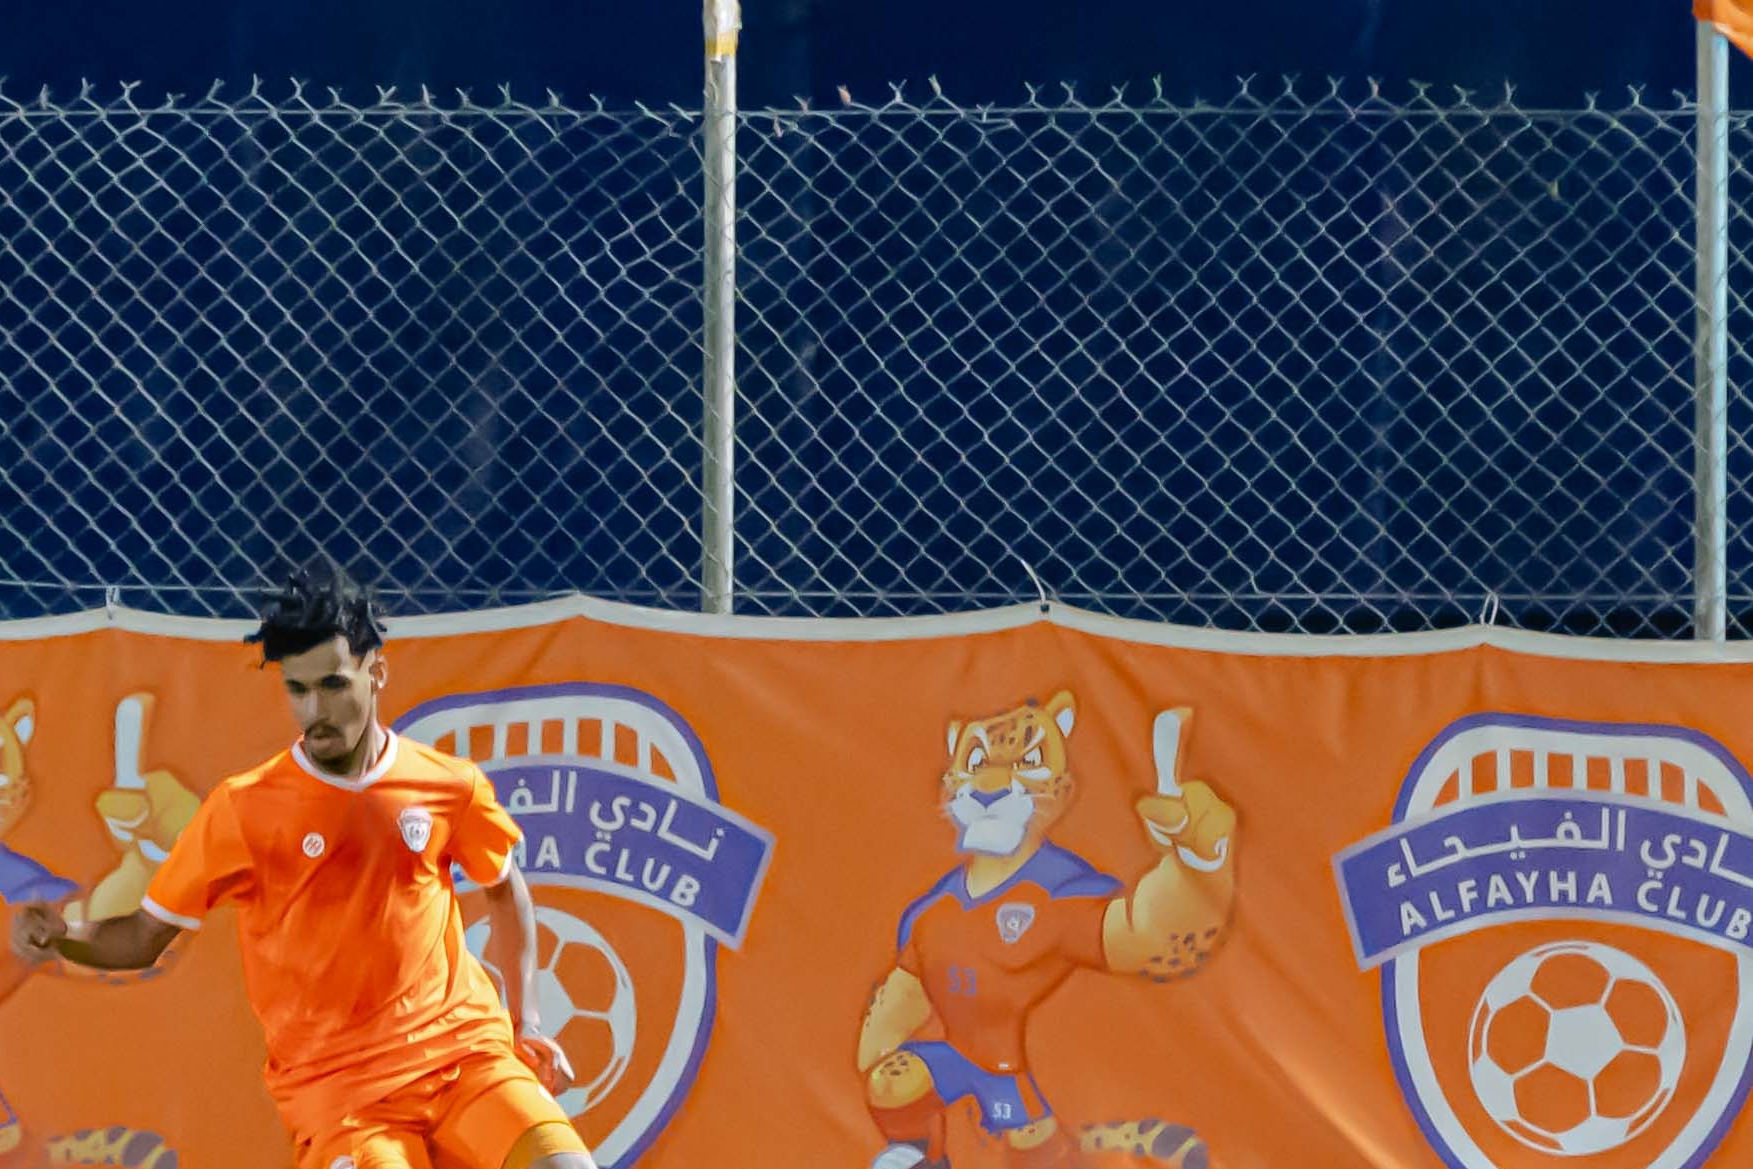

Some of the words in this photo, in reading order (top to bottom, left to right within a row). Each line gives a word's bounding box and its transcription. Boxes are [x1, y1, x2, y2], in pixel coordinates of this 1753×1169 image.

[589, 795, 725, 862] نادي
[1387, 807, 1627, 889] الفيحاء
[1640, 832, 1753, 890] ادي
[584, 841, 701, 907] CLUB
[1399, 870, 1614, 936] ALFAYHA
[1636, 879, 1752, 940] CLUB
[992, 1102, 1012, 1120] 53
